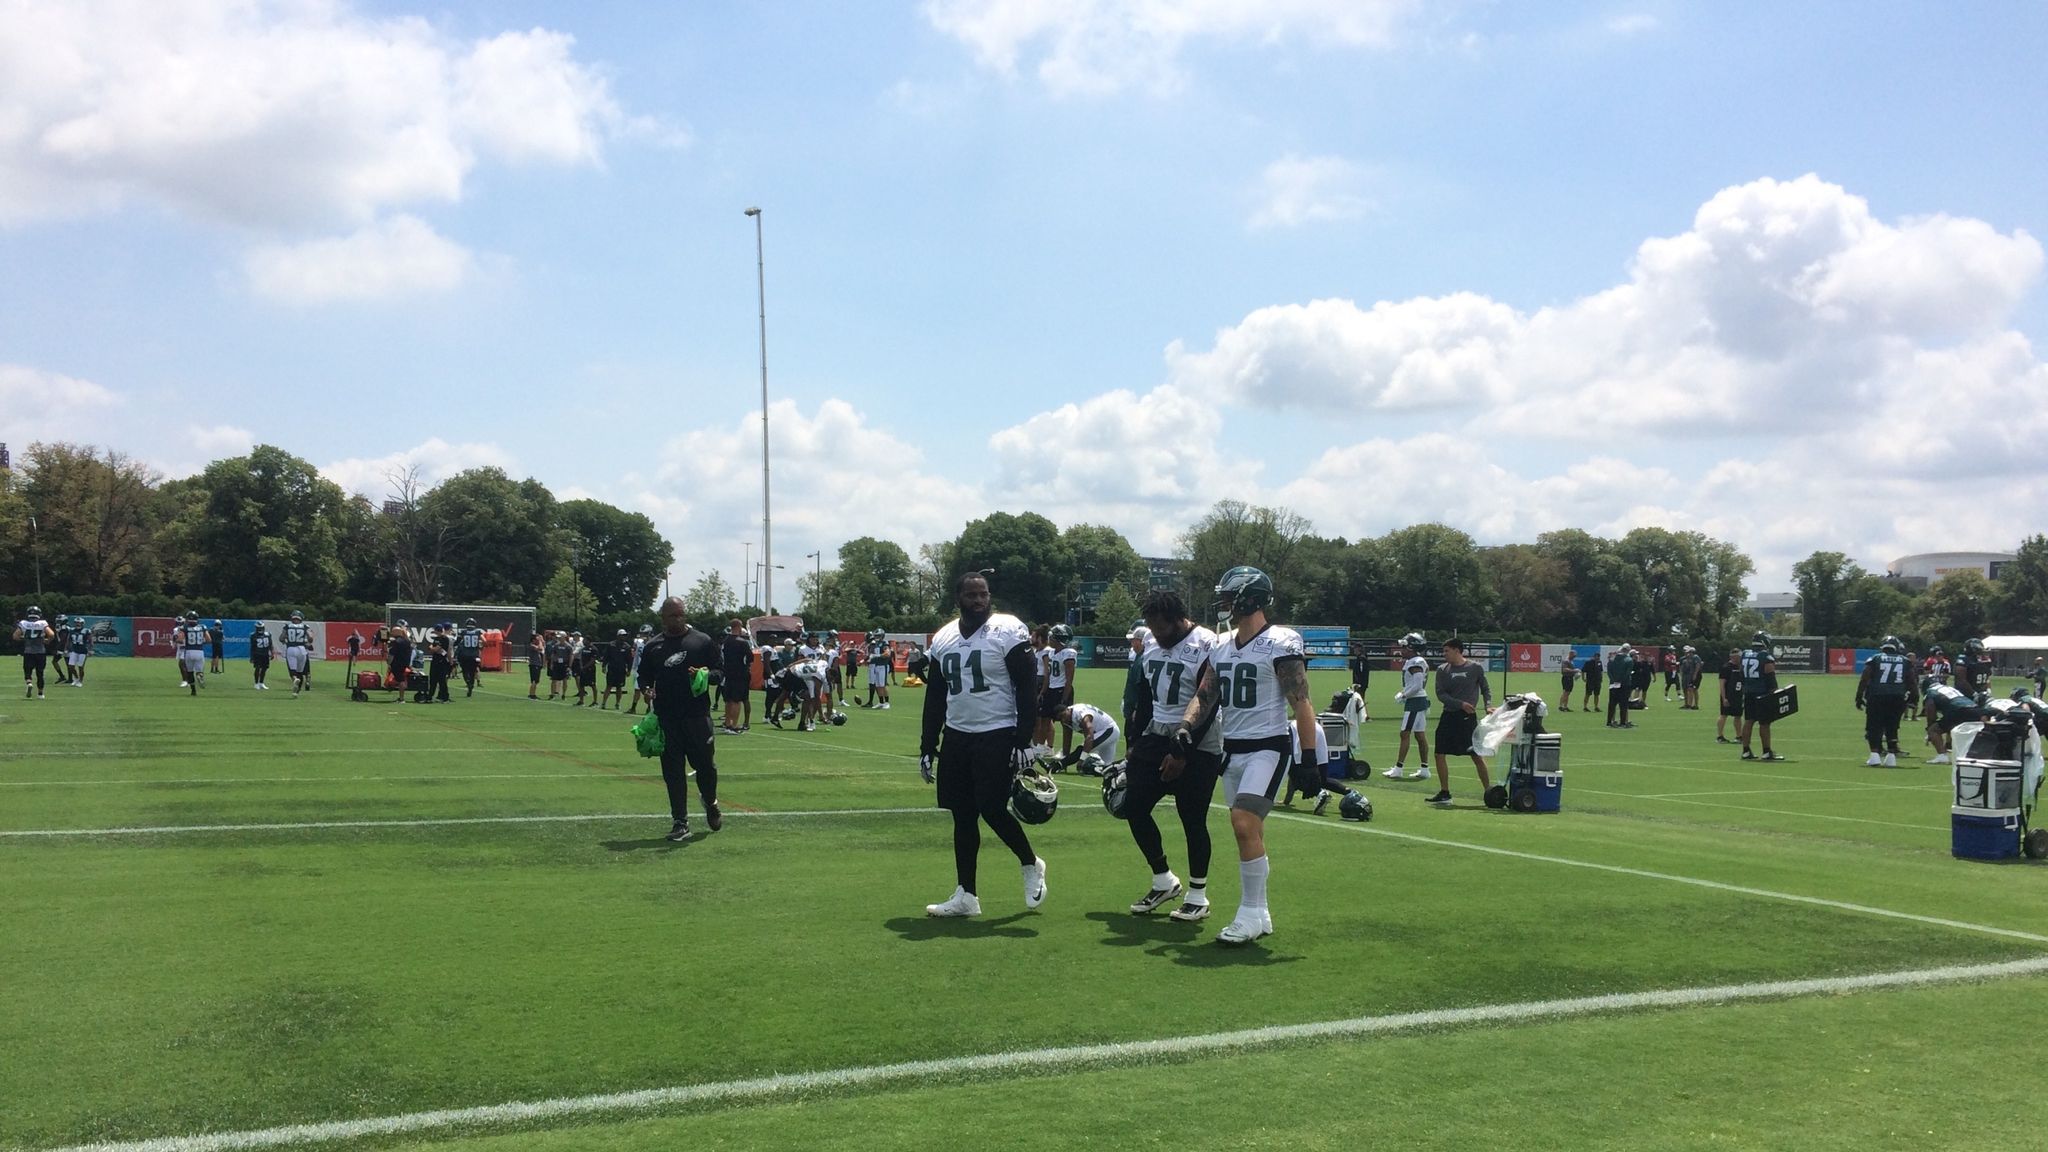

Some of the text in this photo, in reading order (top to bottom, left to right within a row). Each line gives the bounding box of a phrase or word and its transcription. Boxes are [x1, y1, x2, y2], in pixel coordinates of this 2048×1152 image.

[329, 646, 383, 656] Sannder
[1549, 655, 1563, 664] nrg
[942, 649, 990, 696] 91
[1148, 660, 1185, 706] 77
[1216, 662, 1258, 709] 56
[1879, 662, 1904, 684] 71
